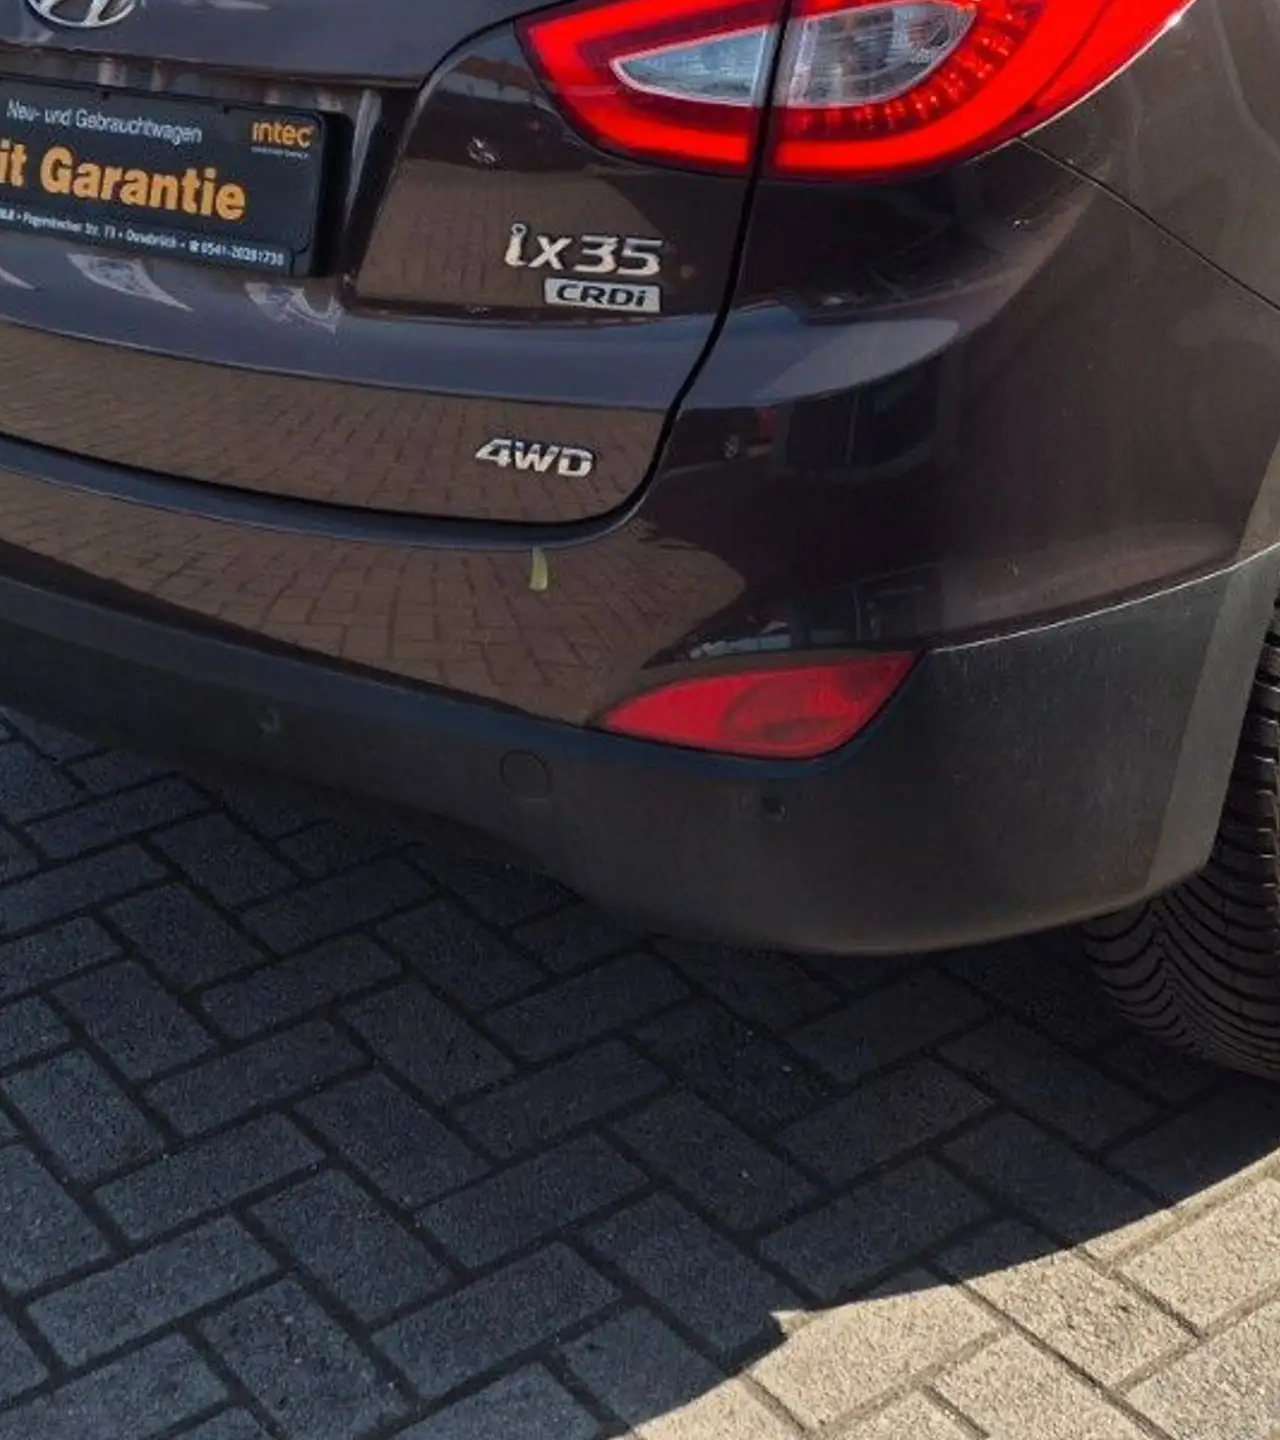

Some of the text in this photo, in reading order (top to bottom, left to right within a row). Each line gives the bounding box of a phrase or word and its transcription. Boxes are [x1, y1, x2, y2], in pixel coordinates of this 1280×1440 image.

[6, 98, 202, 146] Neu- und Gebrauchtwagen
[251, 121, 316, 150] intec
[39, 145, 246, 220] Garantie
[503, 221, 665, 278] ix35
[474, 436, 596, 478] 4WD
